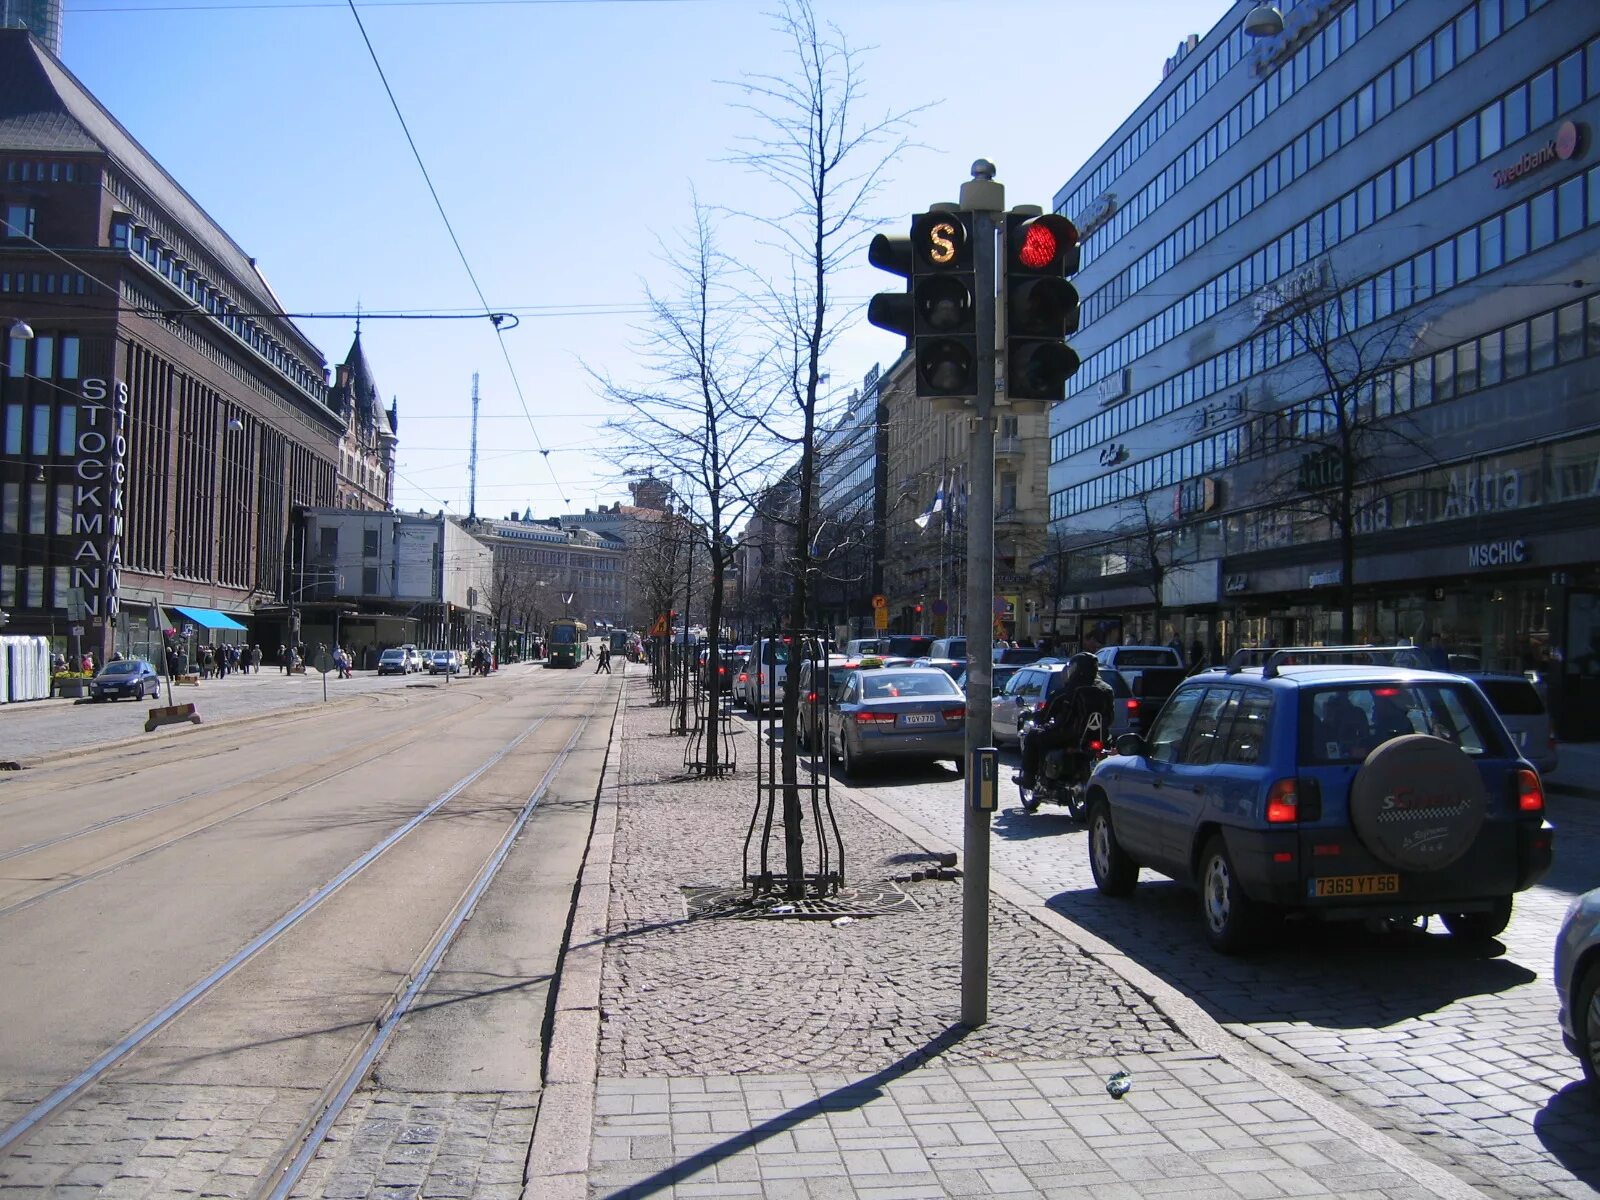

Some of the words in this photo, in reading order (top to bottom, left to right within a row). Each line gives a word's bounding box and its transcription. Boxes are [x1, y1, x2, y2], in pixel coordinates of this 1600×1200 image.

[930, 223, 955, 263] S
[75, 378, 107, 616] STOCKMANN
[111, 381, 129, 617] STOCKMANN
[1443, 459, 1520, 518] Aktia
[1468, 540, 1525, 567] MSCHIC
[1317, 878, 1354, 895] 7369
[1358, 877, 1375, 892] YT
[1377, 876, 1396, 891] 56
